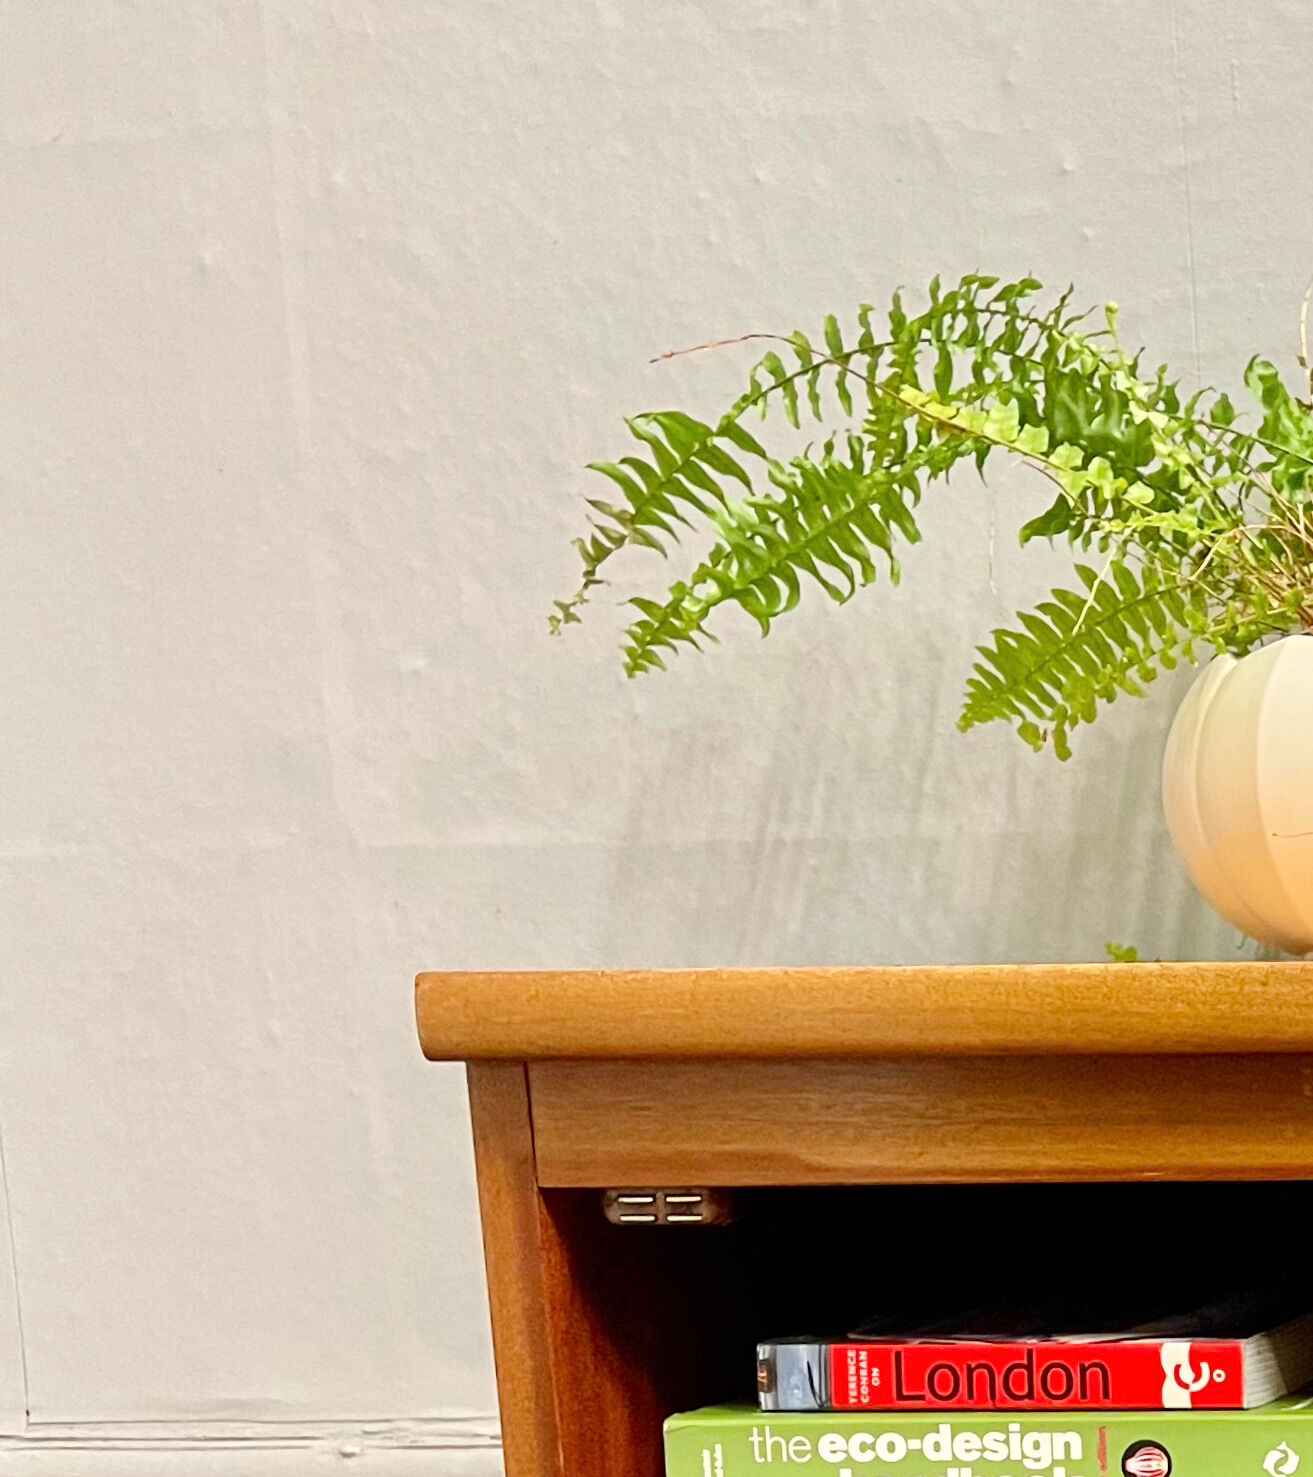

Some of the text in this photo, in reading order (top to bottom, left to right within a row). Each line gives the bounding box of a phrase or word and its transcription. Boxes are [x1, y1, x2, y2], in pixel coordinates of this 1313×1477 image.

[847, 1349, 859, 1405] TERENCE
[859, 1350, 870, 1404] CONRAN
[871, 1367, 881, 1387] ON
[894, 1348, 1110, 1402] London
[748, 1423, 1083, 1470] the eco-design
